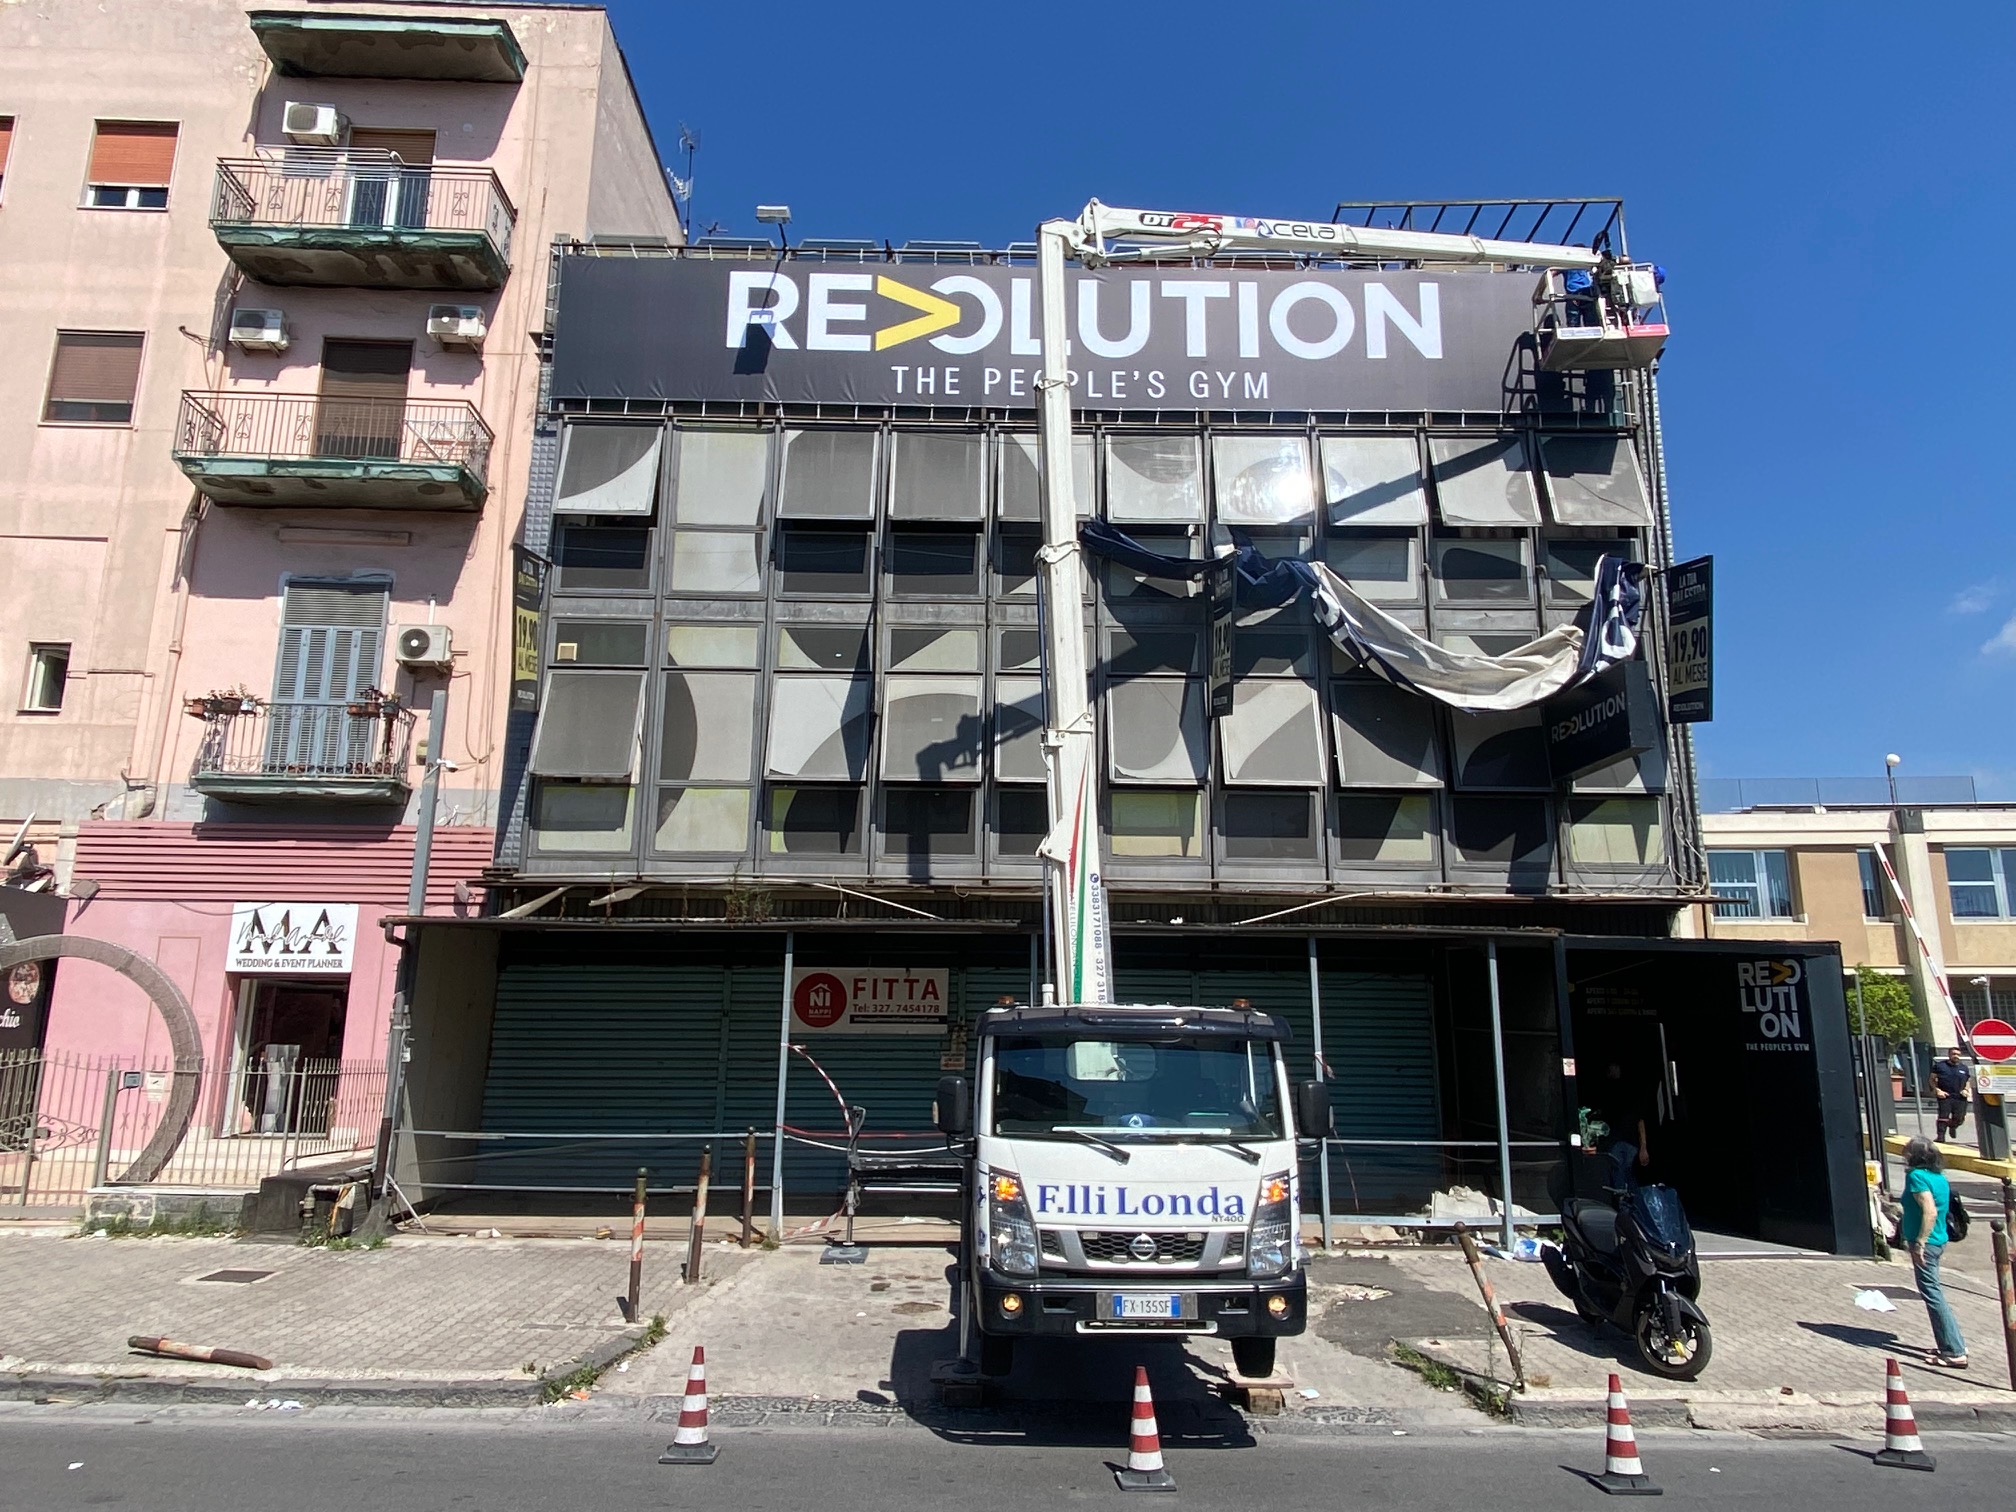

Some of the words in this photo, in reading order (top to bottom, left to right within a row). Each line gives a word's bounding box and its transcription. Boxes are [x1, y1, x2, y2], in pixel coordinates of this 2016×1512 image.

[891, 366, 960, 396] THE
[1190, 370, 1269, 400] GYM
[1673, 625, 1707, 664] 19,90
[1673, 665, 1684, 686] AL
[1685, 662, 1707, 684] MESE
[239, 908, 342, 954] MA
[235, 958, 273, 968] WEDDING
[274, 959, 280, 968] &
[281, 959, 306, 968] EVENT
[307, 959, 343, 968] PLANNER
[1095, 958, 1104, 978] 327
[853, 978, 940, 1001] FITTA
[853, 1003, 870, 1013] Tel:
[896, 1004, 940, 1014] 7454178
[1760, 1012, 1801, 1038] ON
[1037, 1184, 1107, 1215] F.lli
[1116, 1186, 1246, 1216] Londa
